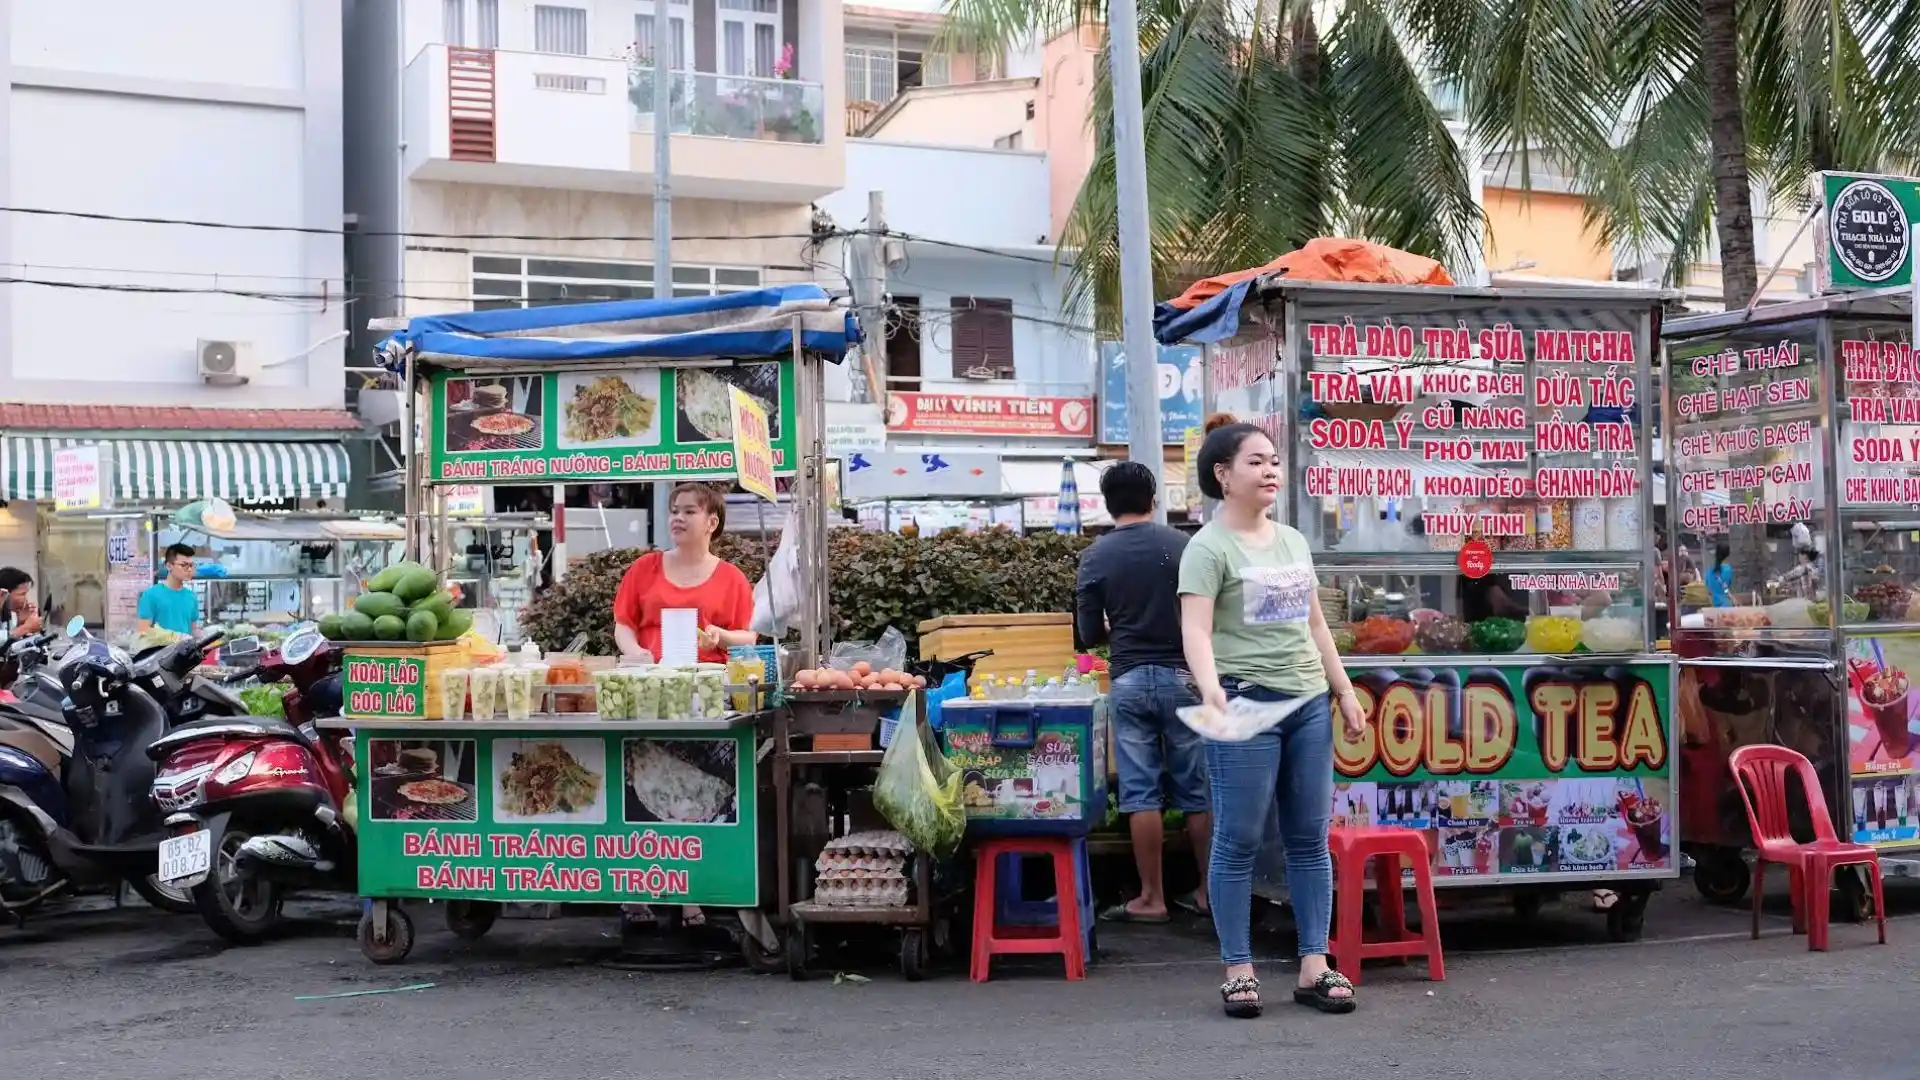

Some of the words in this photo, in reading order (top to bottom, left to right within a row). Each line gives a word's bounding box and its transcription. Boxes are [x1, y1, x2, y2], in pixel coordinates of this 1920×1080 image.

[1852, 210, 1887, 225] GOLD
[1308, 316, 1358, 356] TRÀ
[1365, 317, 1414, 358] ĐÀO
[1423, 320, 1472, 360] TRÀ
[1480, 321, 1526, 361] SỮA
[1535, 330, 1635, 363] MATCHA
[1692, 348, 1740, 377] CHÈ
[1744, 339, 1799, 370] THÁI
[1842, 328, 1881, 381] TRÀ
[1309, 366, 1362, 403] TRÀ
[1370, 363, 1414, 403] VẢI
[1421, 368, 1472, 394] KHÚC
[1476, 373, 1525, 398] BẠCH
[1535, 369, 1584, 407] DỪA
[1588, 365, 1635, 408] TẮC
[1678, 387, 1718, 416] CHÈ
[1722, 384, 1763, 414] HẠT
[1767, 377, 1810, 404] SEN
[1423, 400, 1454, 429] CỦ
[1462, 404, 1526, 429] NĂNG
[1848, 388, 1886, 424] TRÀ
[1309, 418, 1388, 449] SODA
[1394, 413, 1415, 450] Ý
[1535, 409, 1591, 452] HỒNG
[1594, 414, 1636, 452] TRÀ
[1680, 434, 1711, 457] CHÈ
[1715, 425, 1759, 452] KHÚC
[1764, 421, 1811, 449] BẠCH
[442, 457, 486, 478] BÁNH
[490, 455, 546, 475] TRÁNG
[550, 452, 610, 474] NƯỚNG
[623, 450, 671, 472] BÁNH
[673, 448, 734, 470] TRÁNG
[1423, 436, 1474, 461] PHÔ
[1481, 440, 1527, 461] MAI
[1853, 438, 1904, 463] SODA
[1306, 461, 1334, 497] CHÈ
[1337, 460, 1374, 497] KHÚC
[1423, 475, 1481, 498] KHOAI
[1485, 469, 1526, 498] DẺO
[1536, 468, 1595, 498] CHANH
[1600, 462, 1636, 498] DÂY
[1682, 468, 1716, 492] CHÈ
[1423, 507, 1475, 536] THỦY
[1480, 512, 1526, 536] TINH
[1683, 502, 1719, 527] CHÈ
[1725, 497, 1768, 525] TRÁI
[1773, 496, 1813, 522] CÂY
[1509, 574, 1556, 592] THẠCH
[1558, 571, 1590, 590] NHÀ
[1590, 572, 1619, 590] LÀM
[348, 658, 385, 684] XOÀI
[389, 656, 419, 685] LẮC
[351, 687, 382, 712] CÓC
[386, 685, 416, 714] LẮC
[1332, 680, 1516, 776] GOLD
[1531, 679, 1667, 771] TEA
[403, 827, 481, 857] BÁNH
[488, 827, 587, 858] TRÁNG
[594, 829, 702, 860] NƯỚNG
[417, 861, 495, 889] BÁNH
[502, 862, 602, 891] TRÁNG
[608, 864, 688, 898] TRỘN
[1450, 867, 1464, 875] Trà
